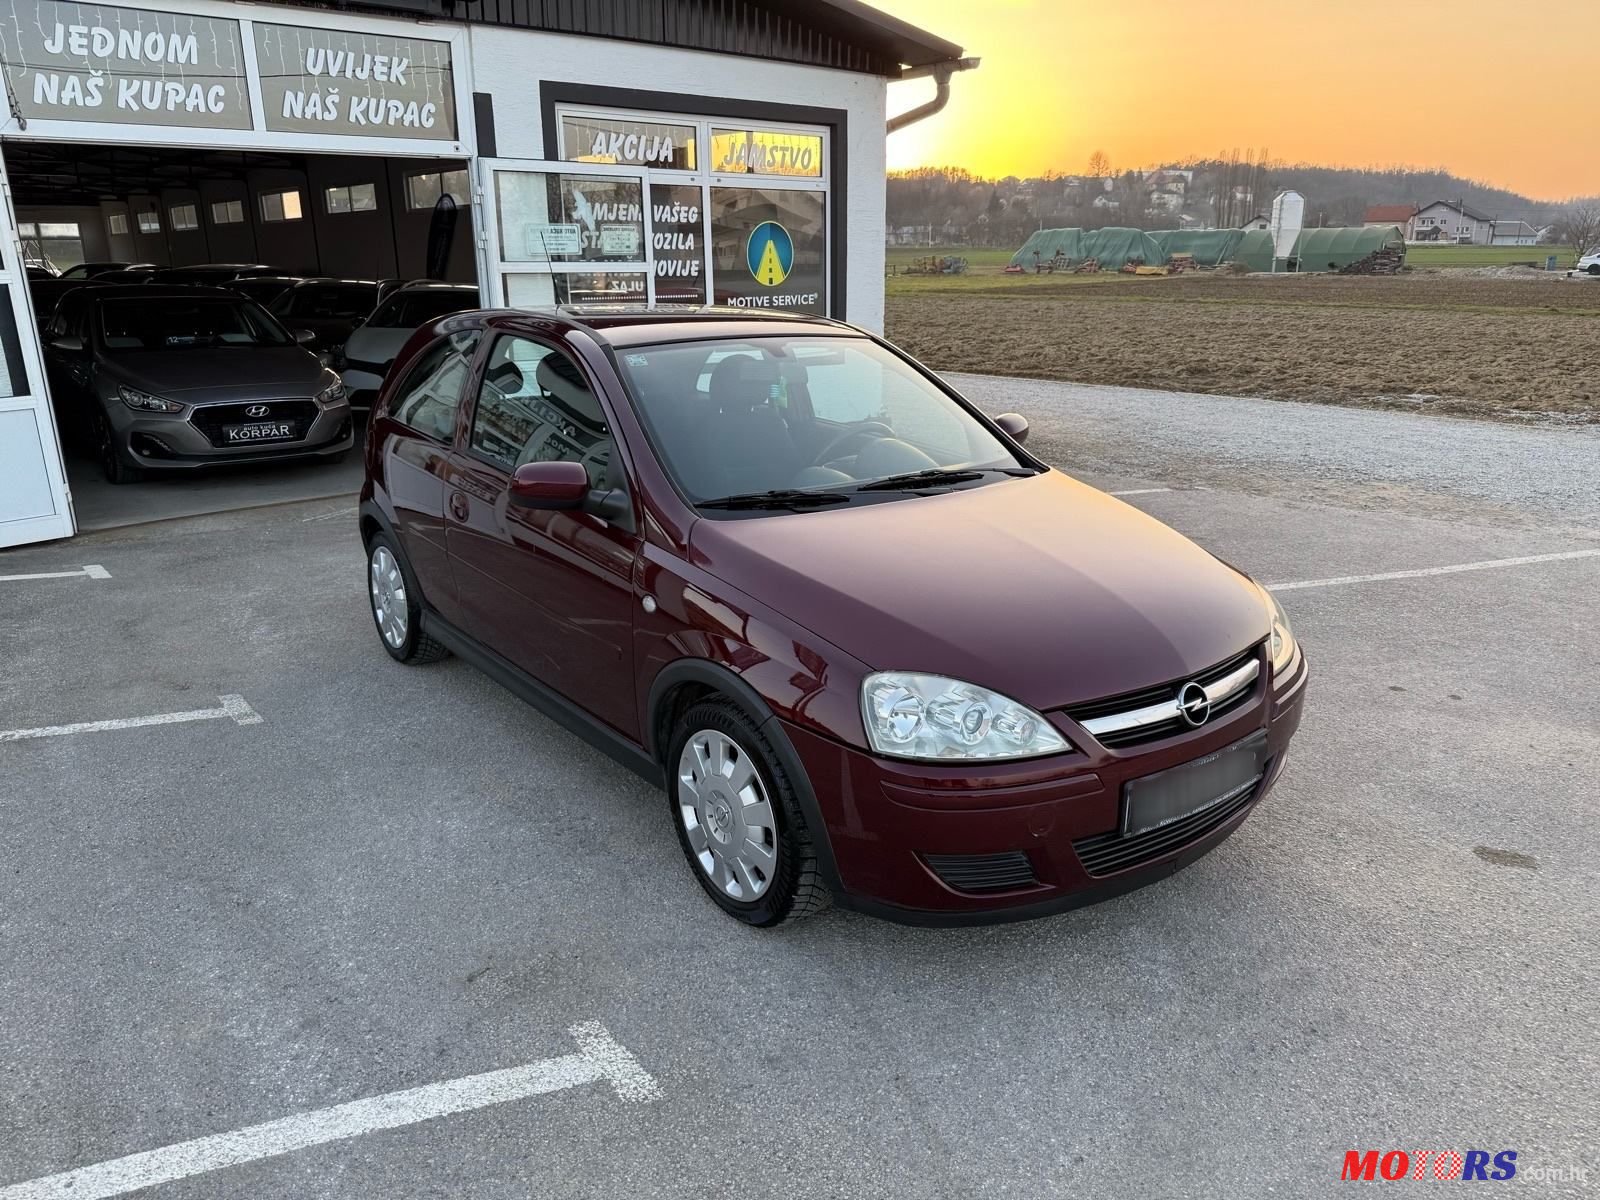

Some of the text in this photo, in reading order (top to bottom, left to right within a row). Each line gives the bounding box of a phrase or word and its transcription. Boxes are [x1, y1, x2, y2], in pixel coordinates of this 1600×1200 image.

[43, 22, 198, 65] JEDNOM
[305, 47, 409, 86] UVIJEK
[33, 69, 226, 114] NAŠ KUPAC
[281, 88, 436, 129] NAŠ KUPAC
[591, 131, 674, 163] AKCIJA
[723, 141, 813, 170] JAMSTVO
[572, 201, 698, 223] MJEN VAŠEG
[652, 233, 695, 250] OZILA
[727, 296, 770, 307] MOTIVE
[229, 425, 290, 440] KORPAR
